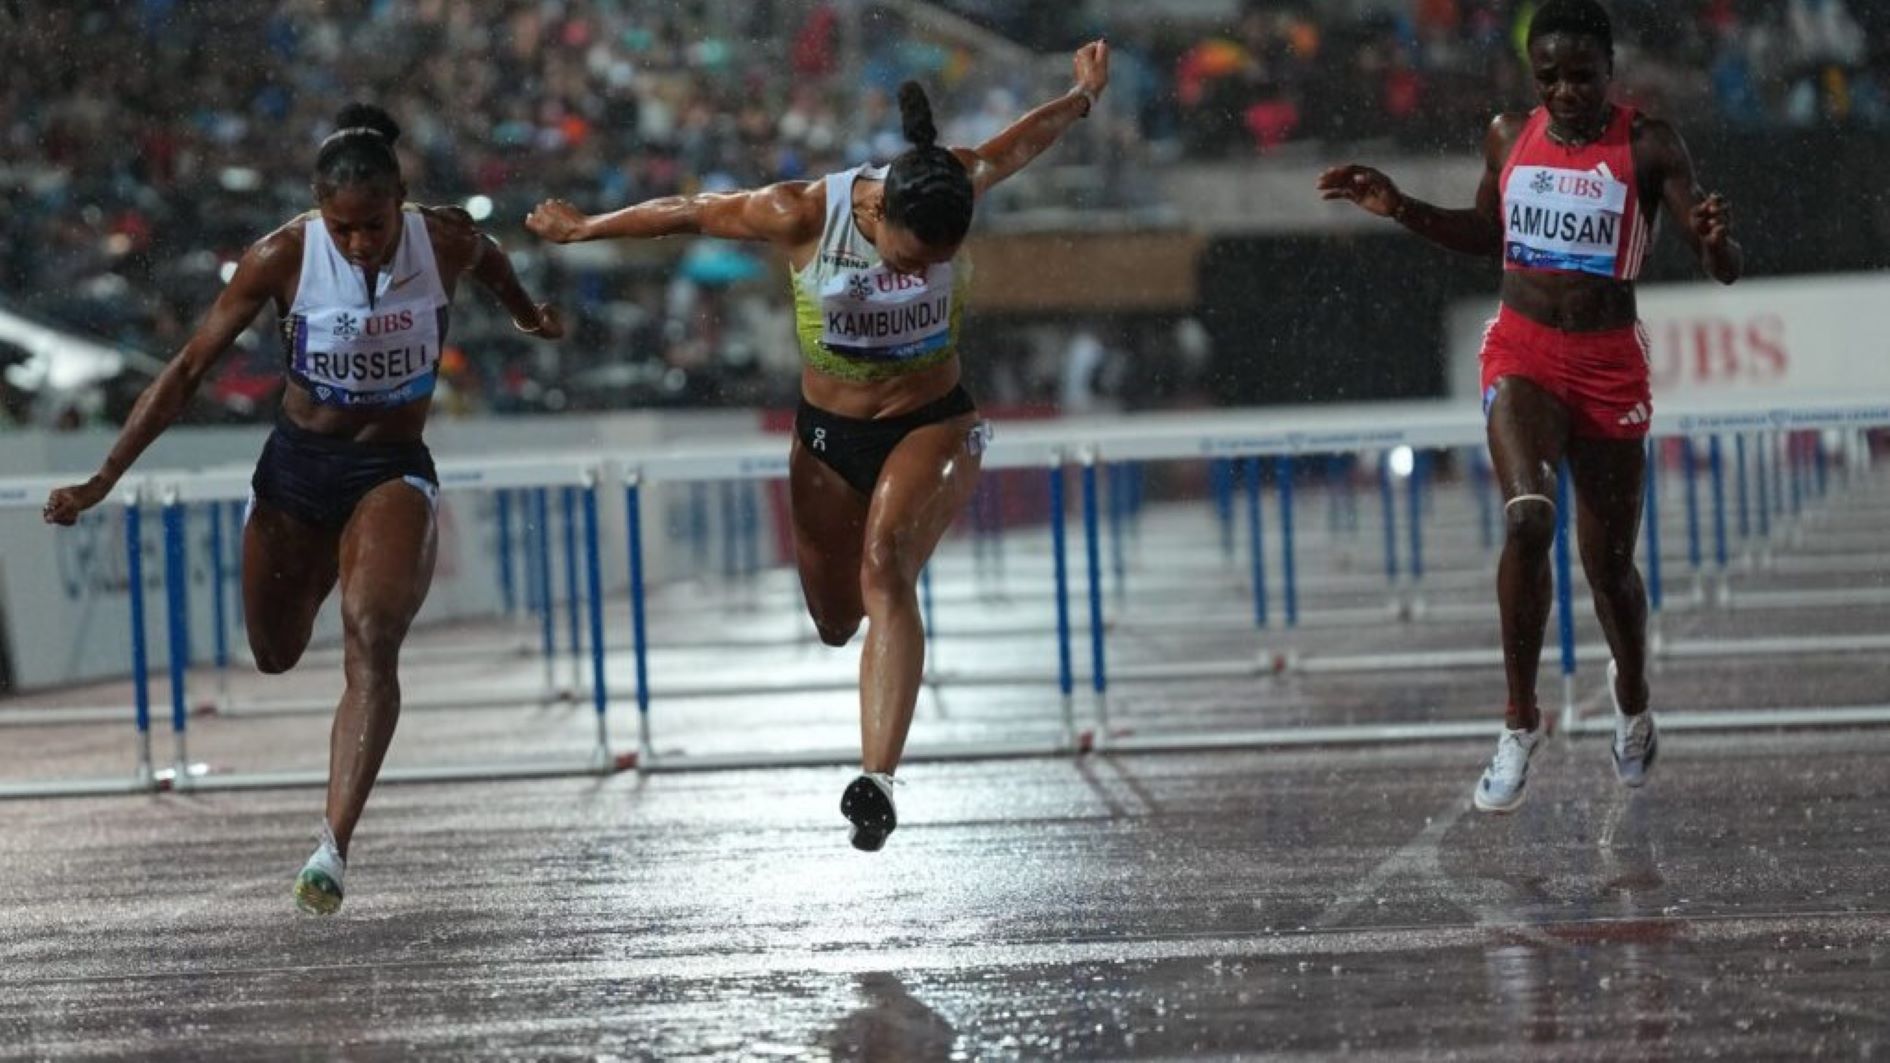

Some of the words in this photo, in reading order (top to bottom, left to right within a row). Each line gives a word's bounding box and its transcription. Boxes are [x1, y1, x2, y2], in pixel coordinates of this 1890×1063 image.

[1558, 176, 1604, 199] UBS
[1510, 203, 1615, 245] AMUSAN
[365, 310, 413, 336] UBS
[828, 295, 947, 337] KAMBUNDJI
